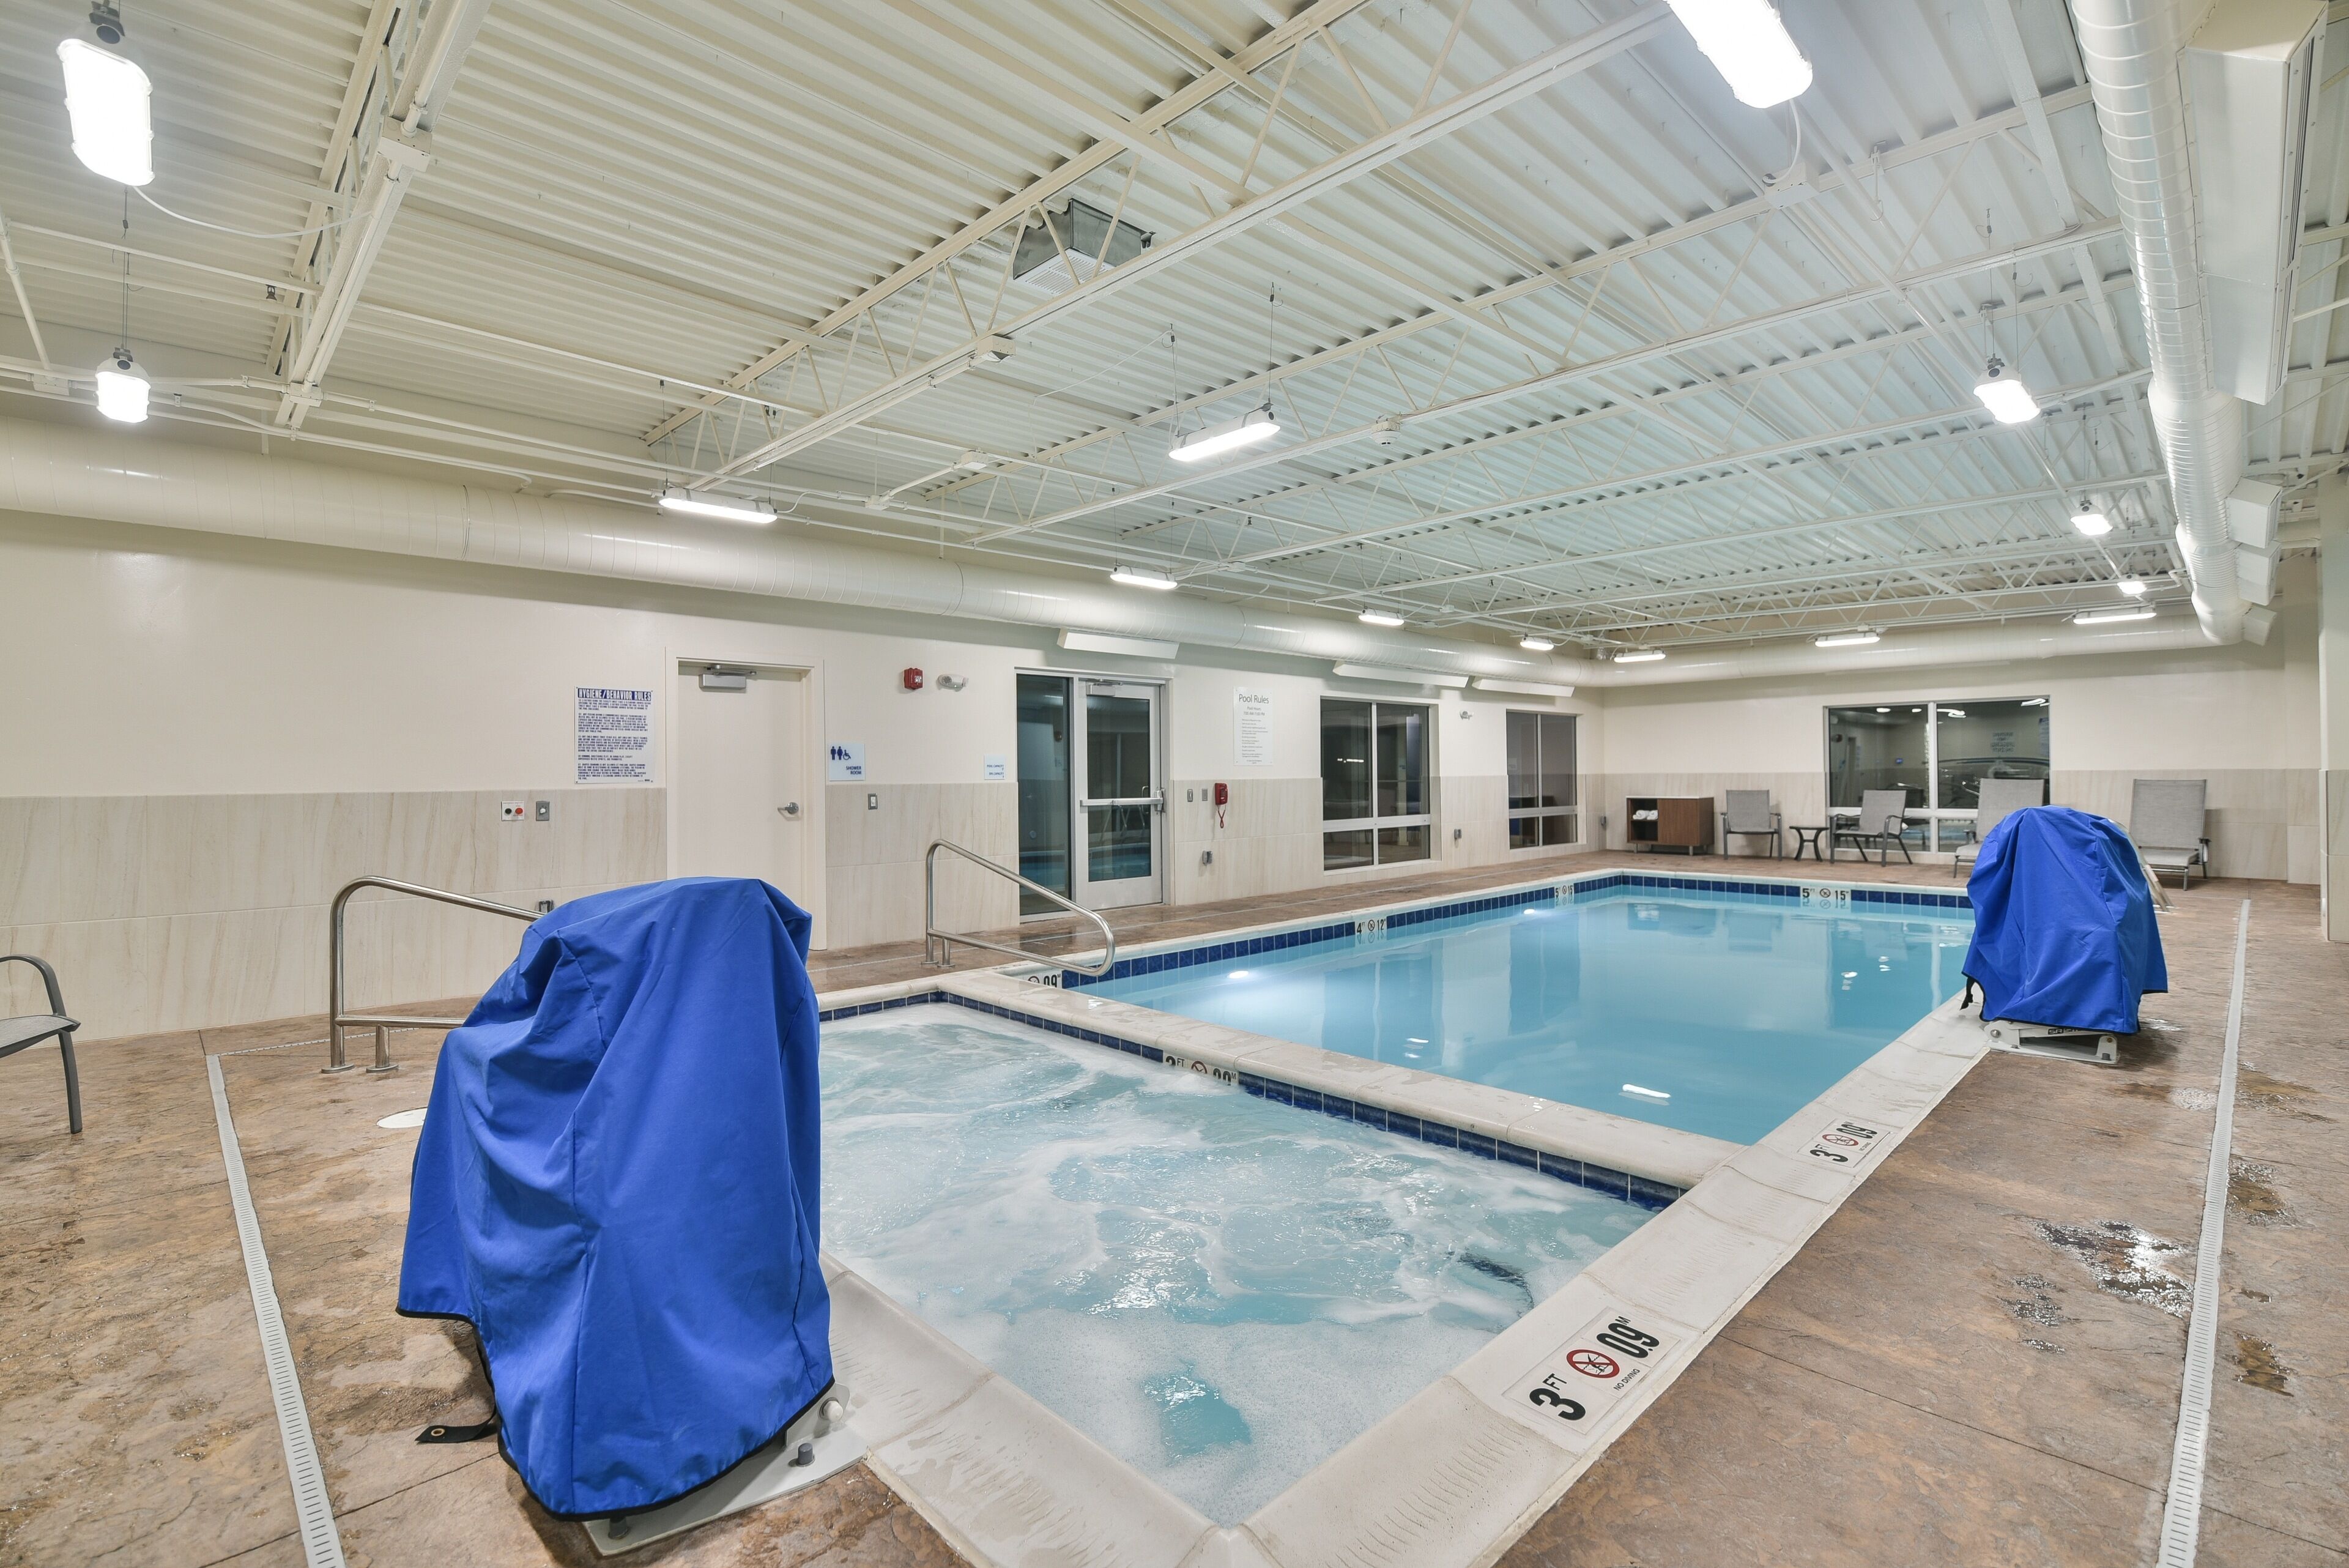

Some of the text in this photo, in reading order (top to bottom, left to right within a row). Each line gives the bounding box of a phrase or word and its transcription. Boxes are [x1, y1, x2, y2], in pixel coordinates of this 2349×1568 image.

[579, 688, 651, 702] HYGIENE/BEHAVIOR RULES
[1239, 694, 1269, 704] Pool Rules
[1803, 888, 1810, 898] 5
[1356, 923, 1362, 934] 4
[1809, 1149, 1849, 1162] 3
[1613, 1368, 1641, 1391] NO DIVING
[1529, 1373, 1586, 1421] 3 FT
